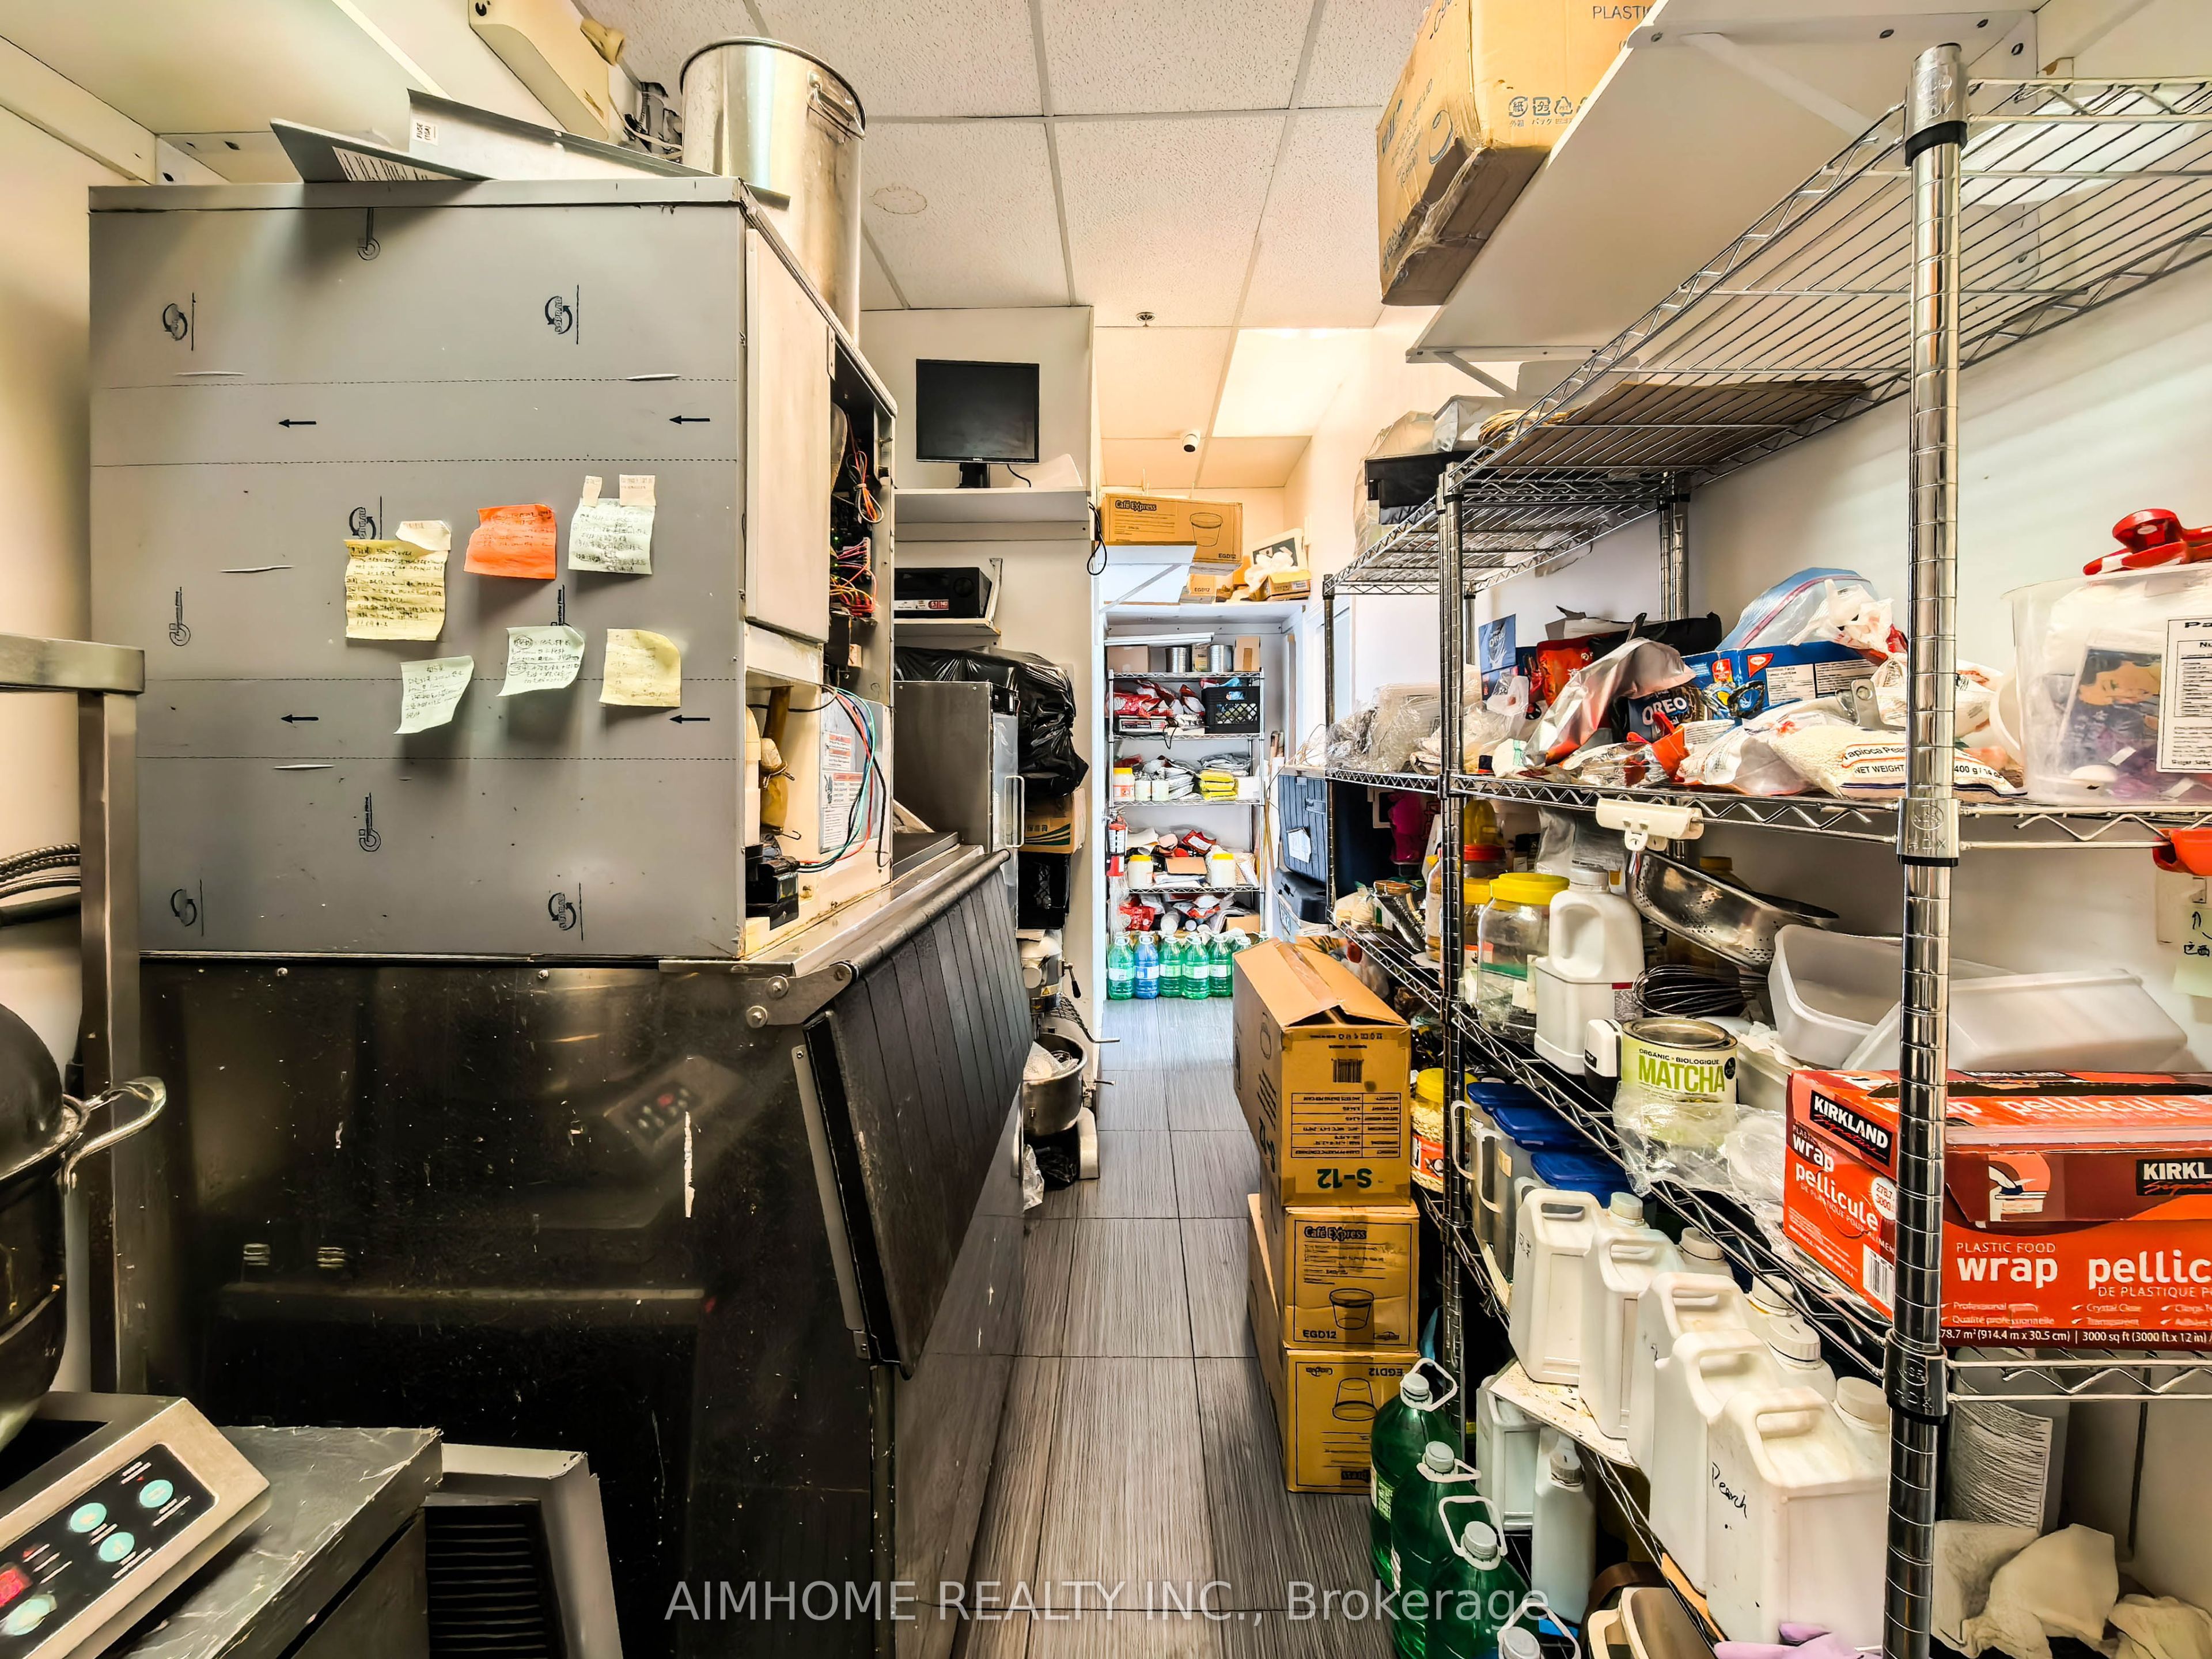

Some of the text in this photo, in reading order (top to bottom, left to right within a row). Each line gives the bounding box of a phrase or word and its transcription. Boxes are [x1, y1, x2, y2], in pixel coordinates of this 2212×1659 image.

[1115, 499, 1130, 510] Café
[1642, 697, 1687, 726] OREO
[1873, 764, 1904, 773] WEIGHT
[1638, 1048, 1720, 1066] ORGANIC BIOLOGIQUE
[1638, 1055, 1725, 1093] MATCHA
[1815, 1096, 1888, 1149] KIRKLAND
[1793, 1134, 1835, 1173] wrap
[1316, 1167, 1373, 1190] S-12
[1796, 1162, 1879, 1232] pellicule
[1303, 1225, 1327, 1239] Café
[1956, 1242, 2056, 1254] PLASTIC FOOD
[1956, 1256, 2059, 1289] wrap
[2097, 1286, 2115, 1297] DE
[2120, 1286, 2196, 1299] PLASTIQUE
[1302, 1329, 1337, 1339] EGD12
[2028, 1331, 2050, 1340] 30.5
[2052, 1331, 2070, 1342] cm)
[2082, 1331, 2107, 1341] 3000
[2109, 1334, 2120, 1343] sq
